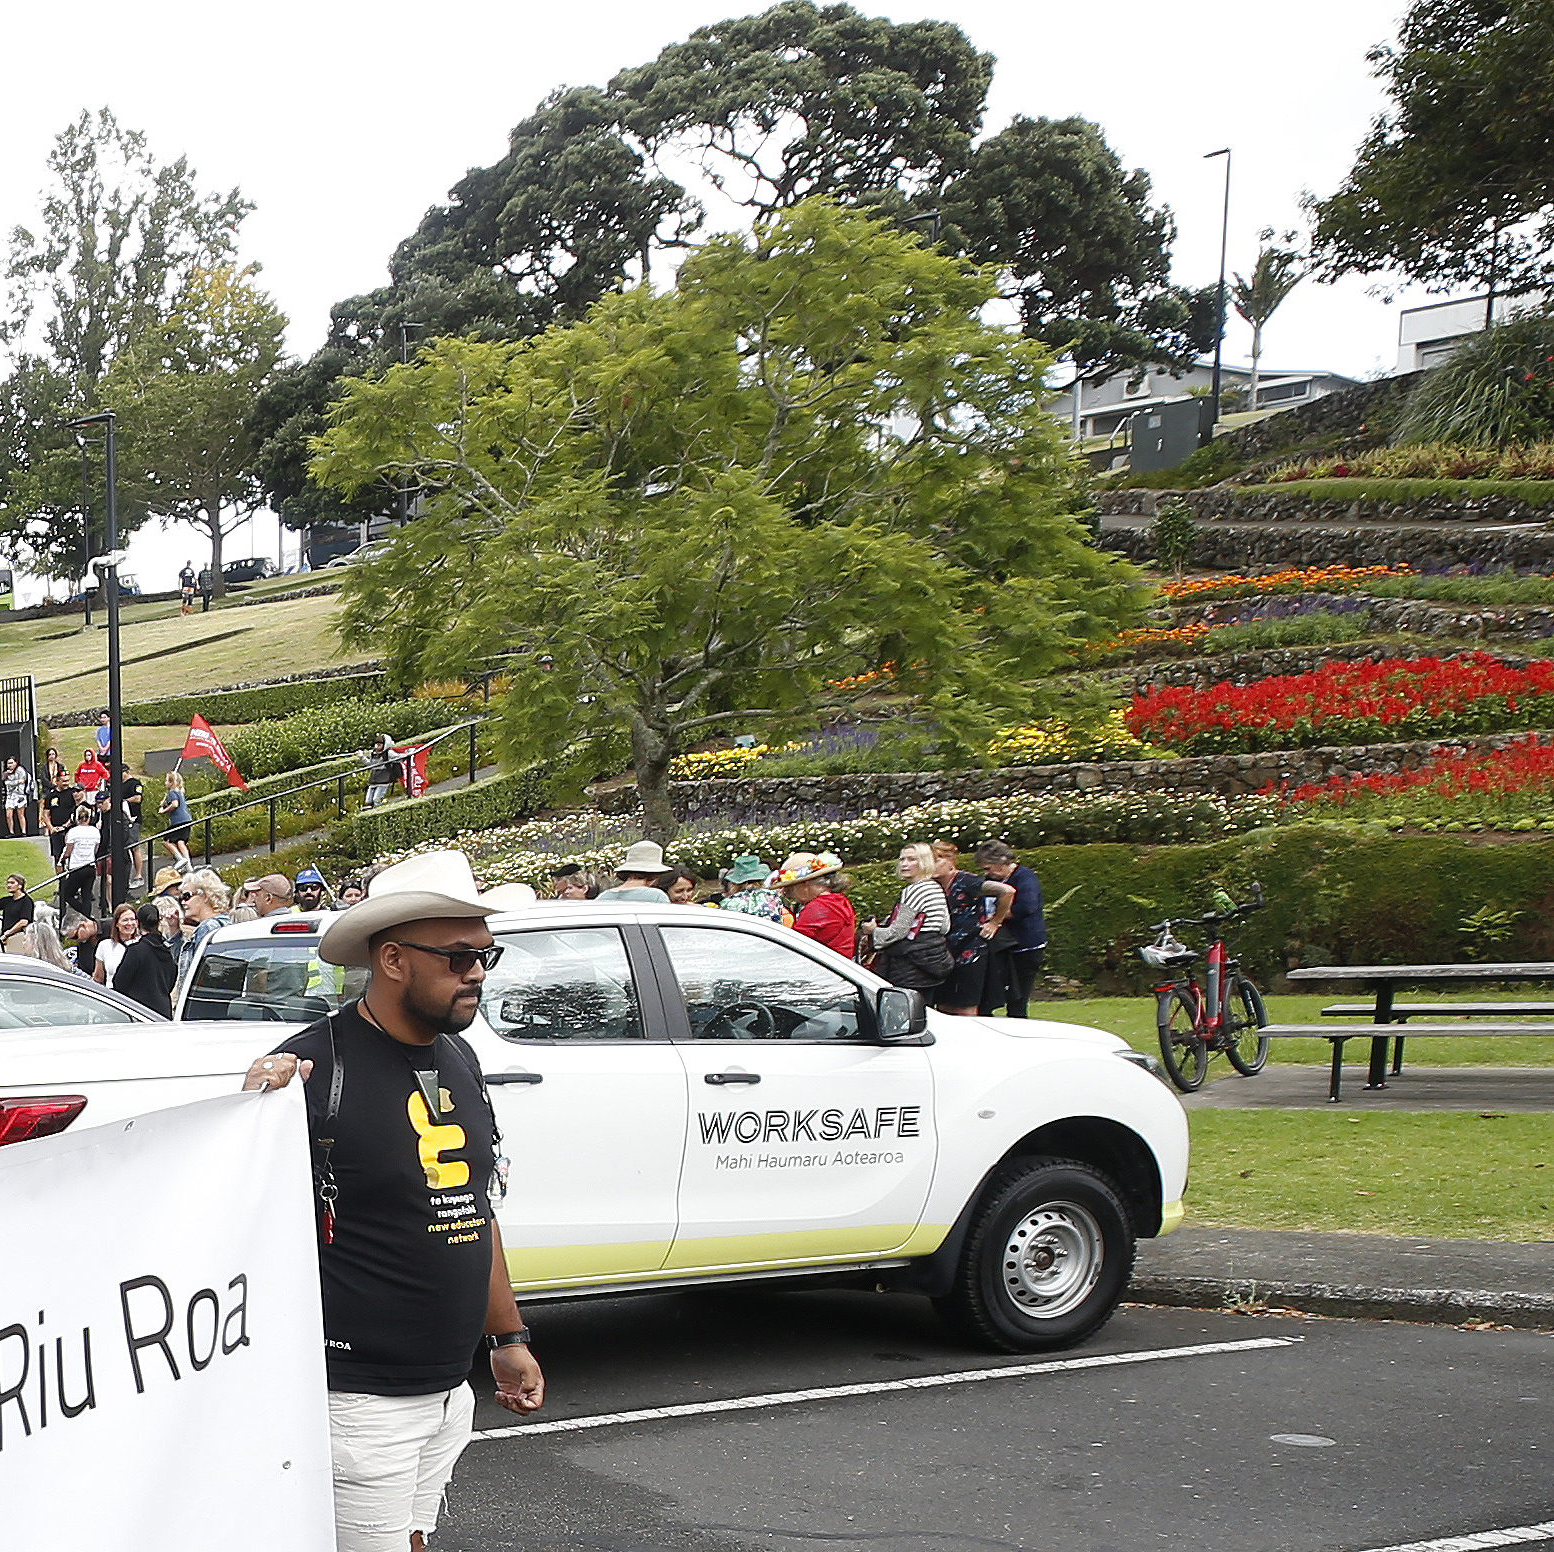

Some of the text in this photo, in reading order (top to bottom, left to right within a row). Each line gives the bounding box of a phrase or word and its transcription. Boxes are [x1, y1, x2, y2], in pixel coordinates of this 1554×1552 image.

[697, 1105, 921, 1145] WORKSAFE
[714, 1150, 905, 1170] Mahi Haumaru Aotearoa
[428, 1223, 450, 1233] new
[447, 1231, 480, 1245] network
[119, 1271, 250, 1396] Roa
[329, 1339, 352, 1351] ROA
